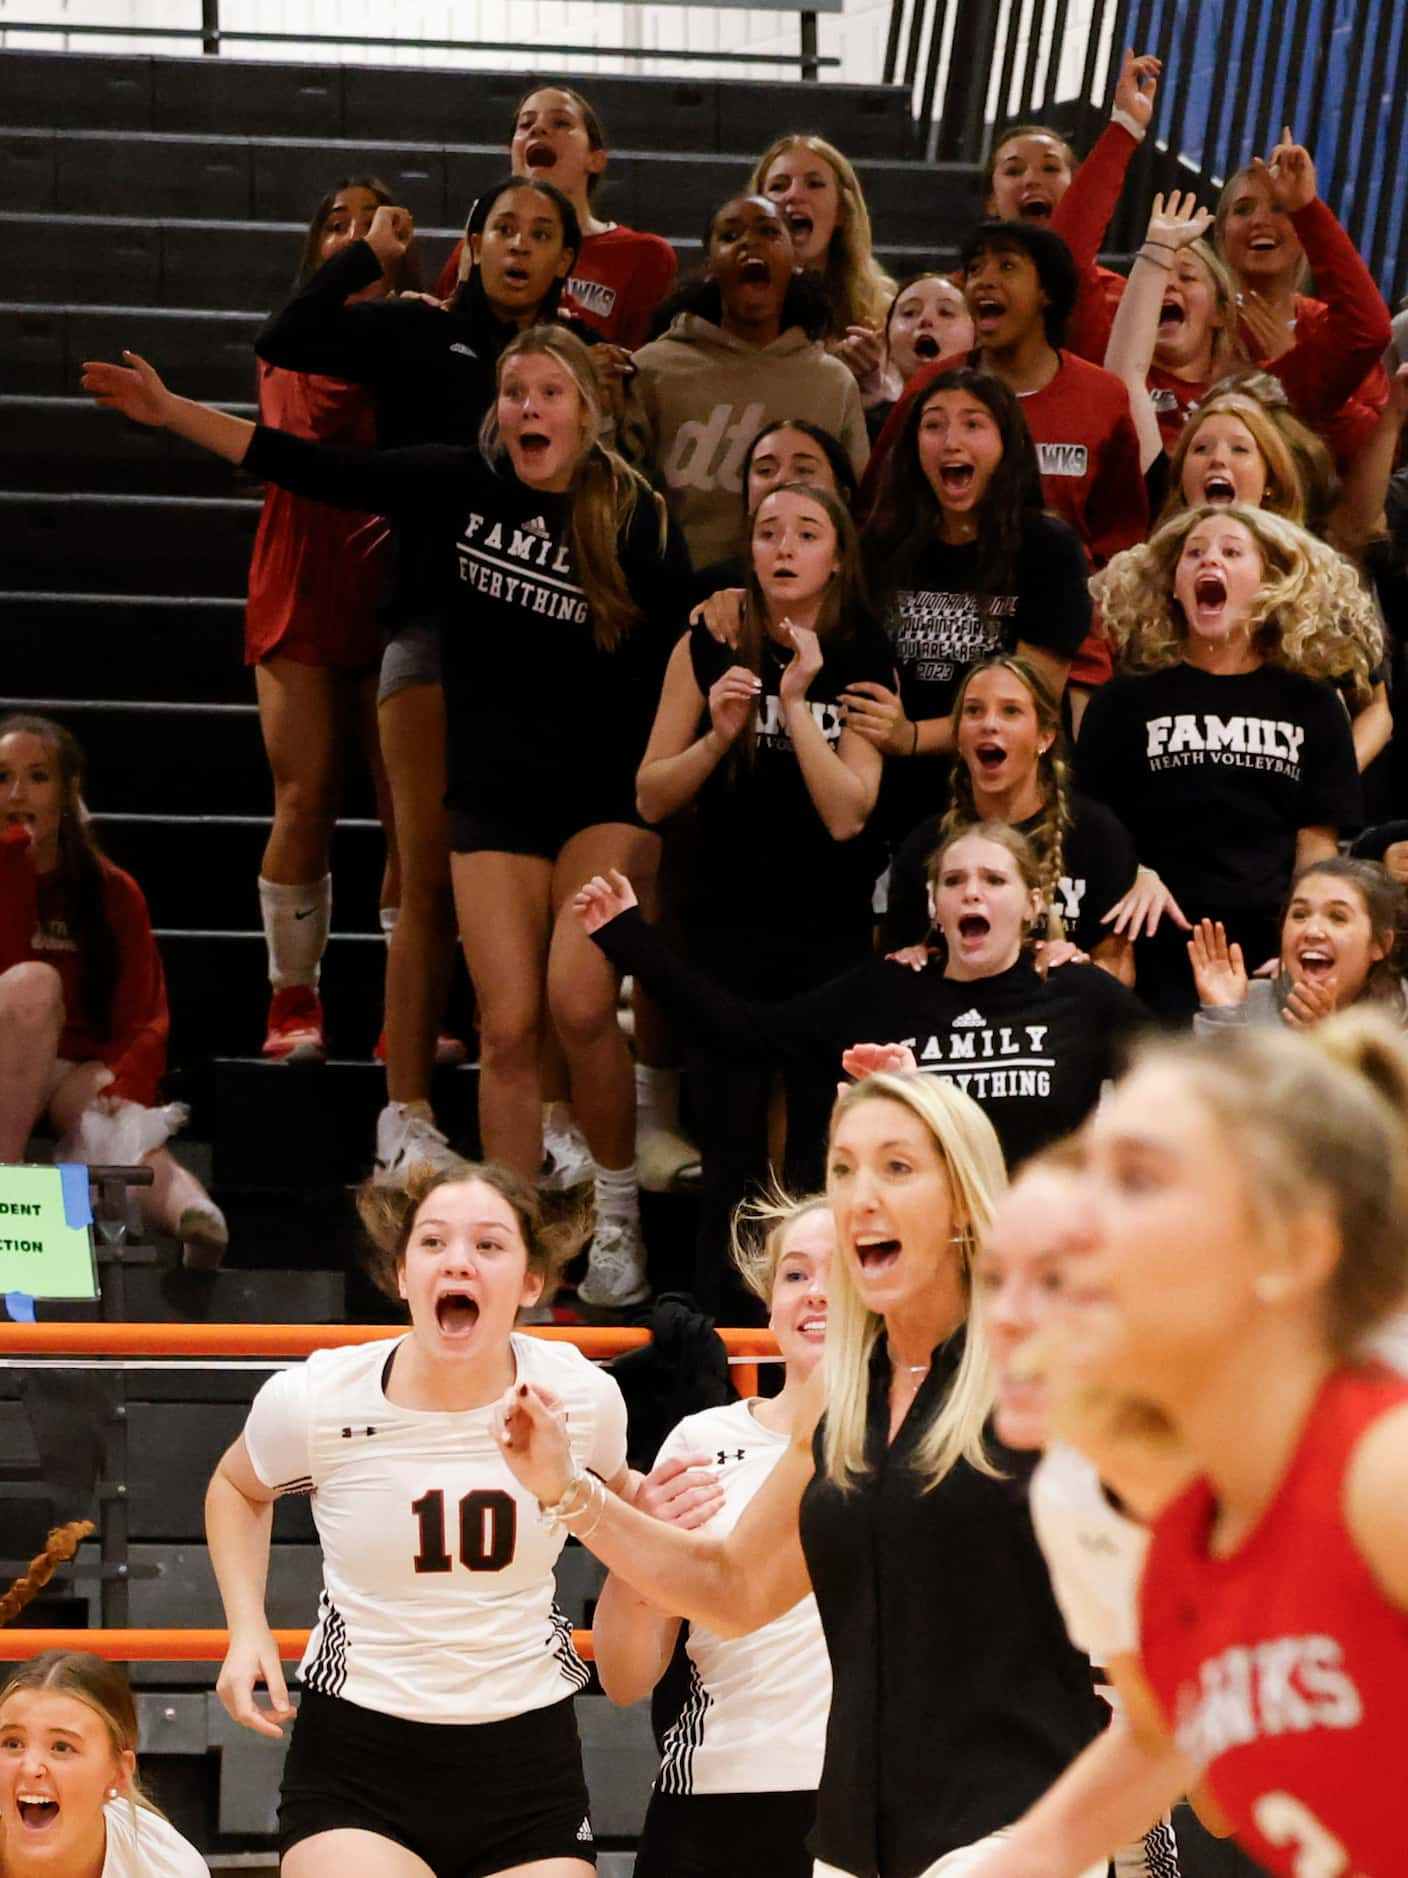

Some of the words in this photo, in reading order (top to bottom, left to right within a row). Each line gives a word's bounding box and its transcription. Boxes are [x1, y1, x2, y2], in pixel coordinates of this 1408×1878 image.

[1037, 444, 1087, 477] WKS
[464, 513, 571, 574] FAMIL
[459, 557, 589, 624] EVERYTHING
[1146, 714, 1304, 764] FAMILY
[1150, 752, 1204, 771] HEATH
[1210, 752, 1301, 781] VOLLEYBALL
[899, 1026, 1049, 1061] AMILY
[947, 1070, 1051, 1099] YTHING
[411, 1489, 517, 1575] 10
